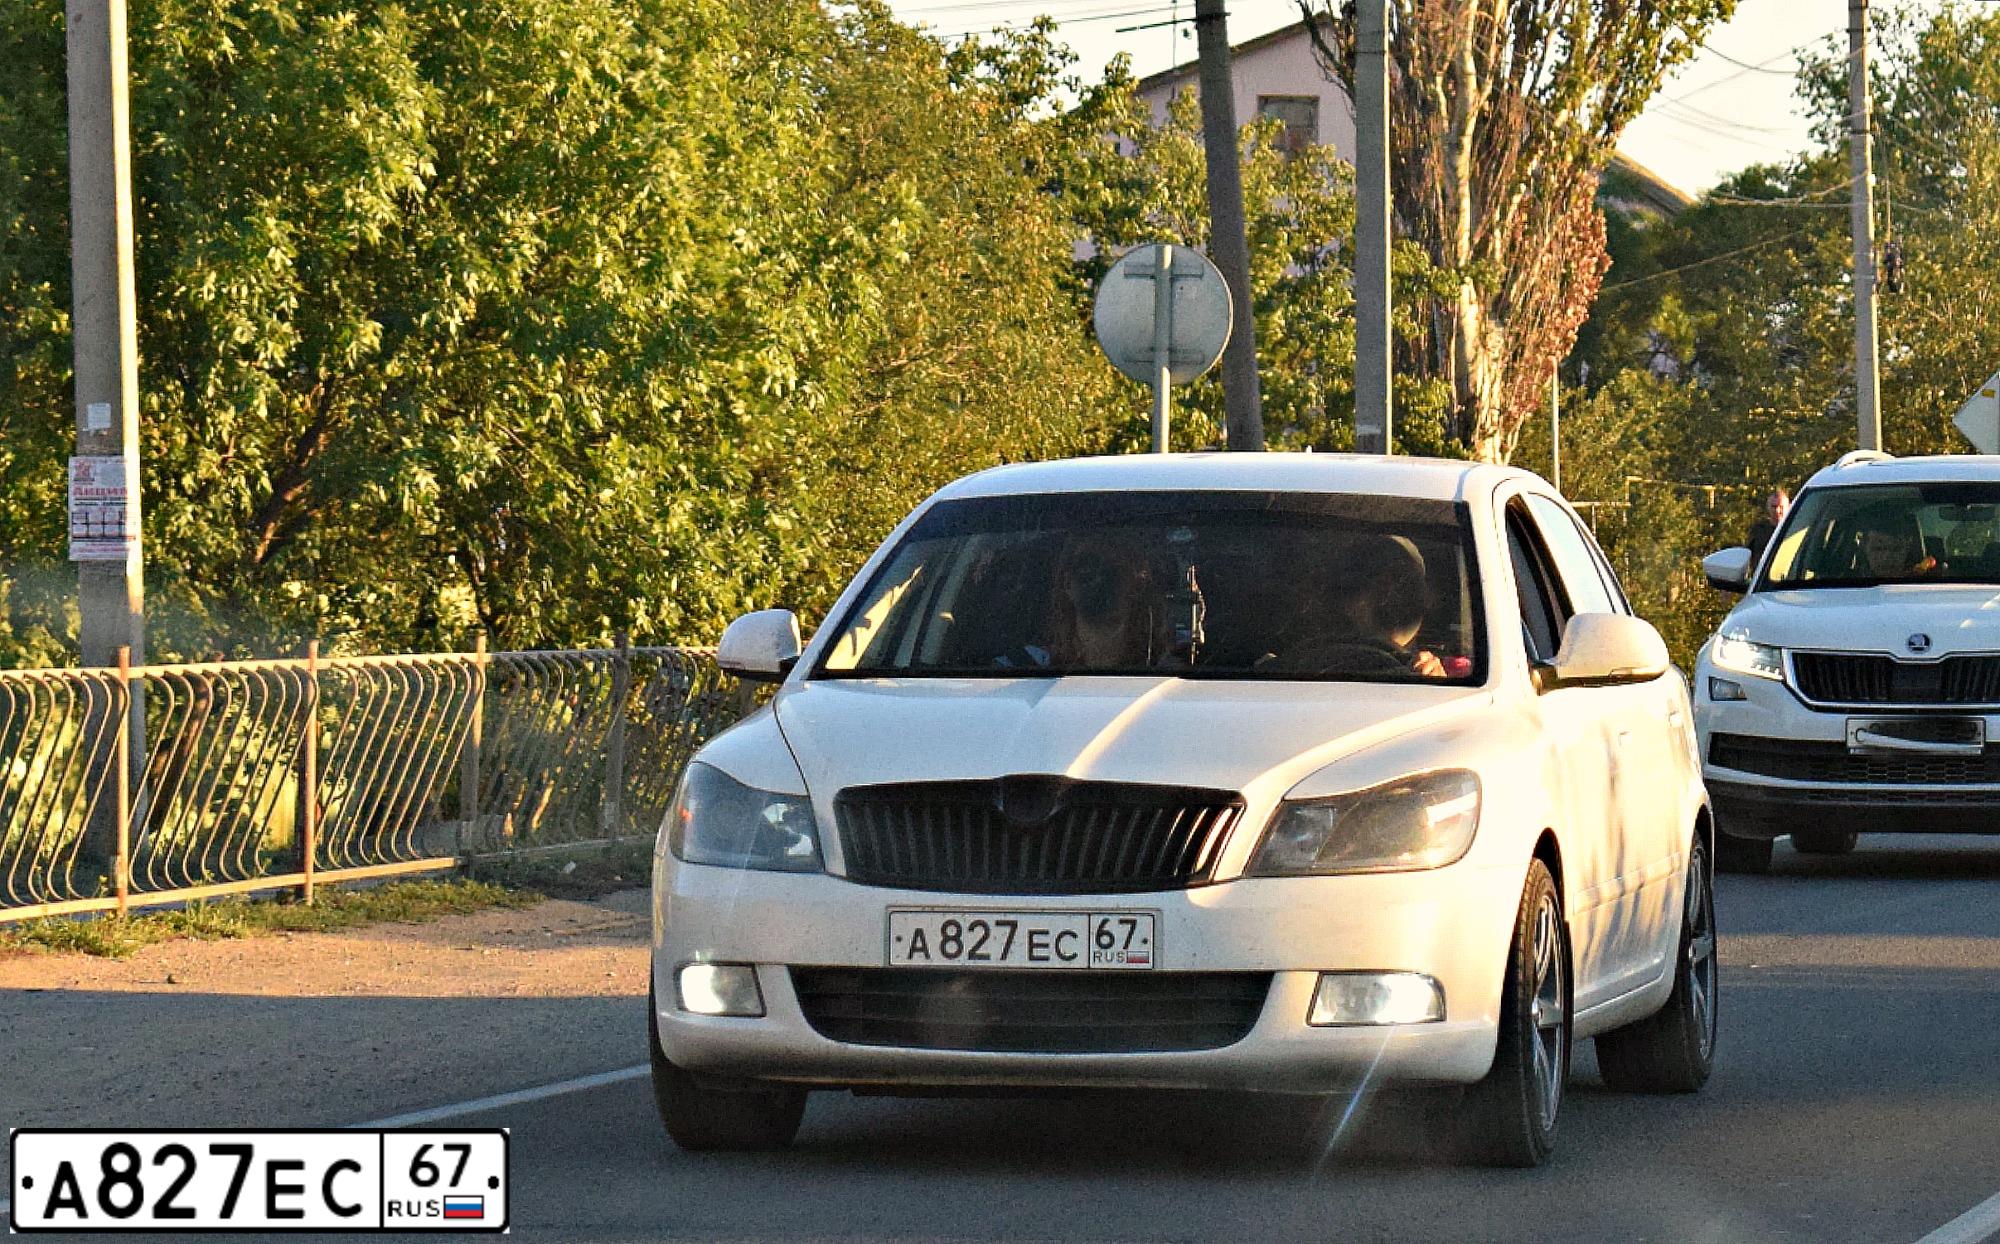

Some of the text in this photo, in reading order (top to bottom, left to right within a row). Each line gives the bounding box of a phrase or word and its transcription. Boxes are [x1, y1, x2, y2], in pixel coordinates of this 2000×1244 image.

[907, 918, 1137, 961] А827ЕС 67
[1093, 951, 1125, 964] RUS
